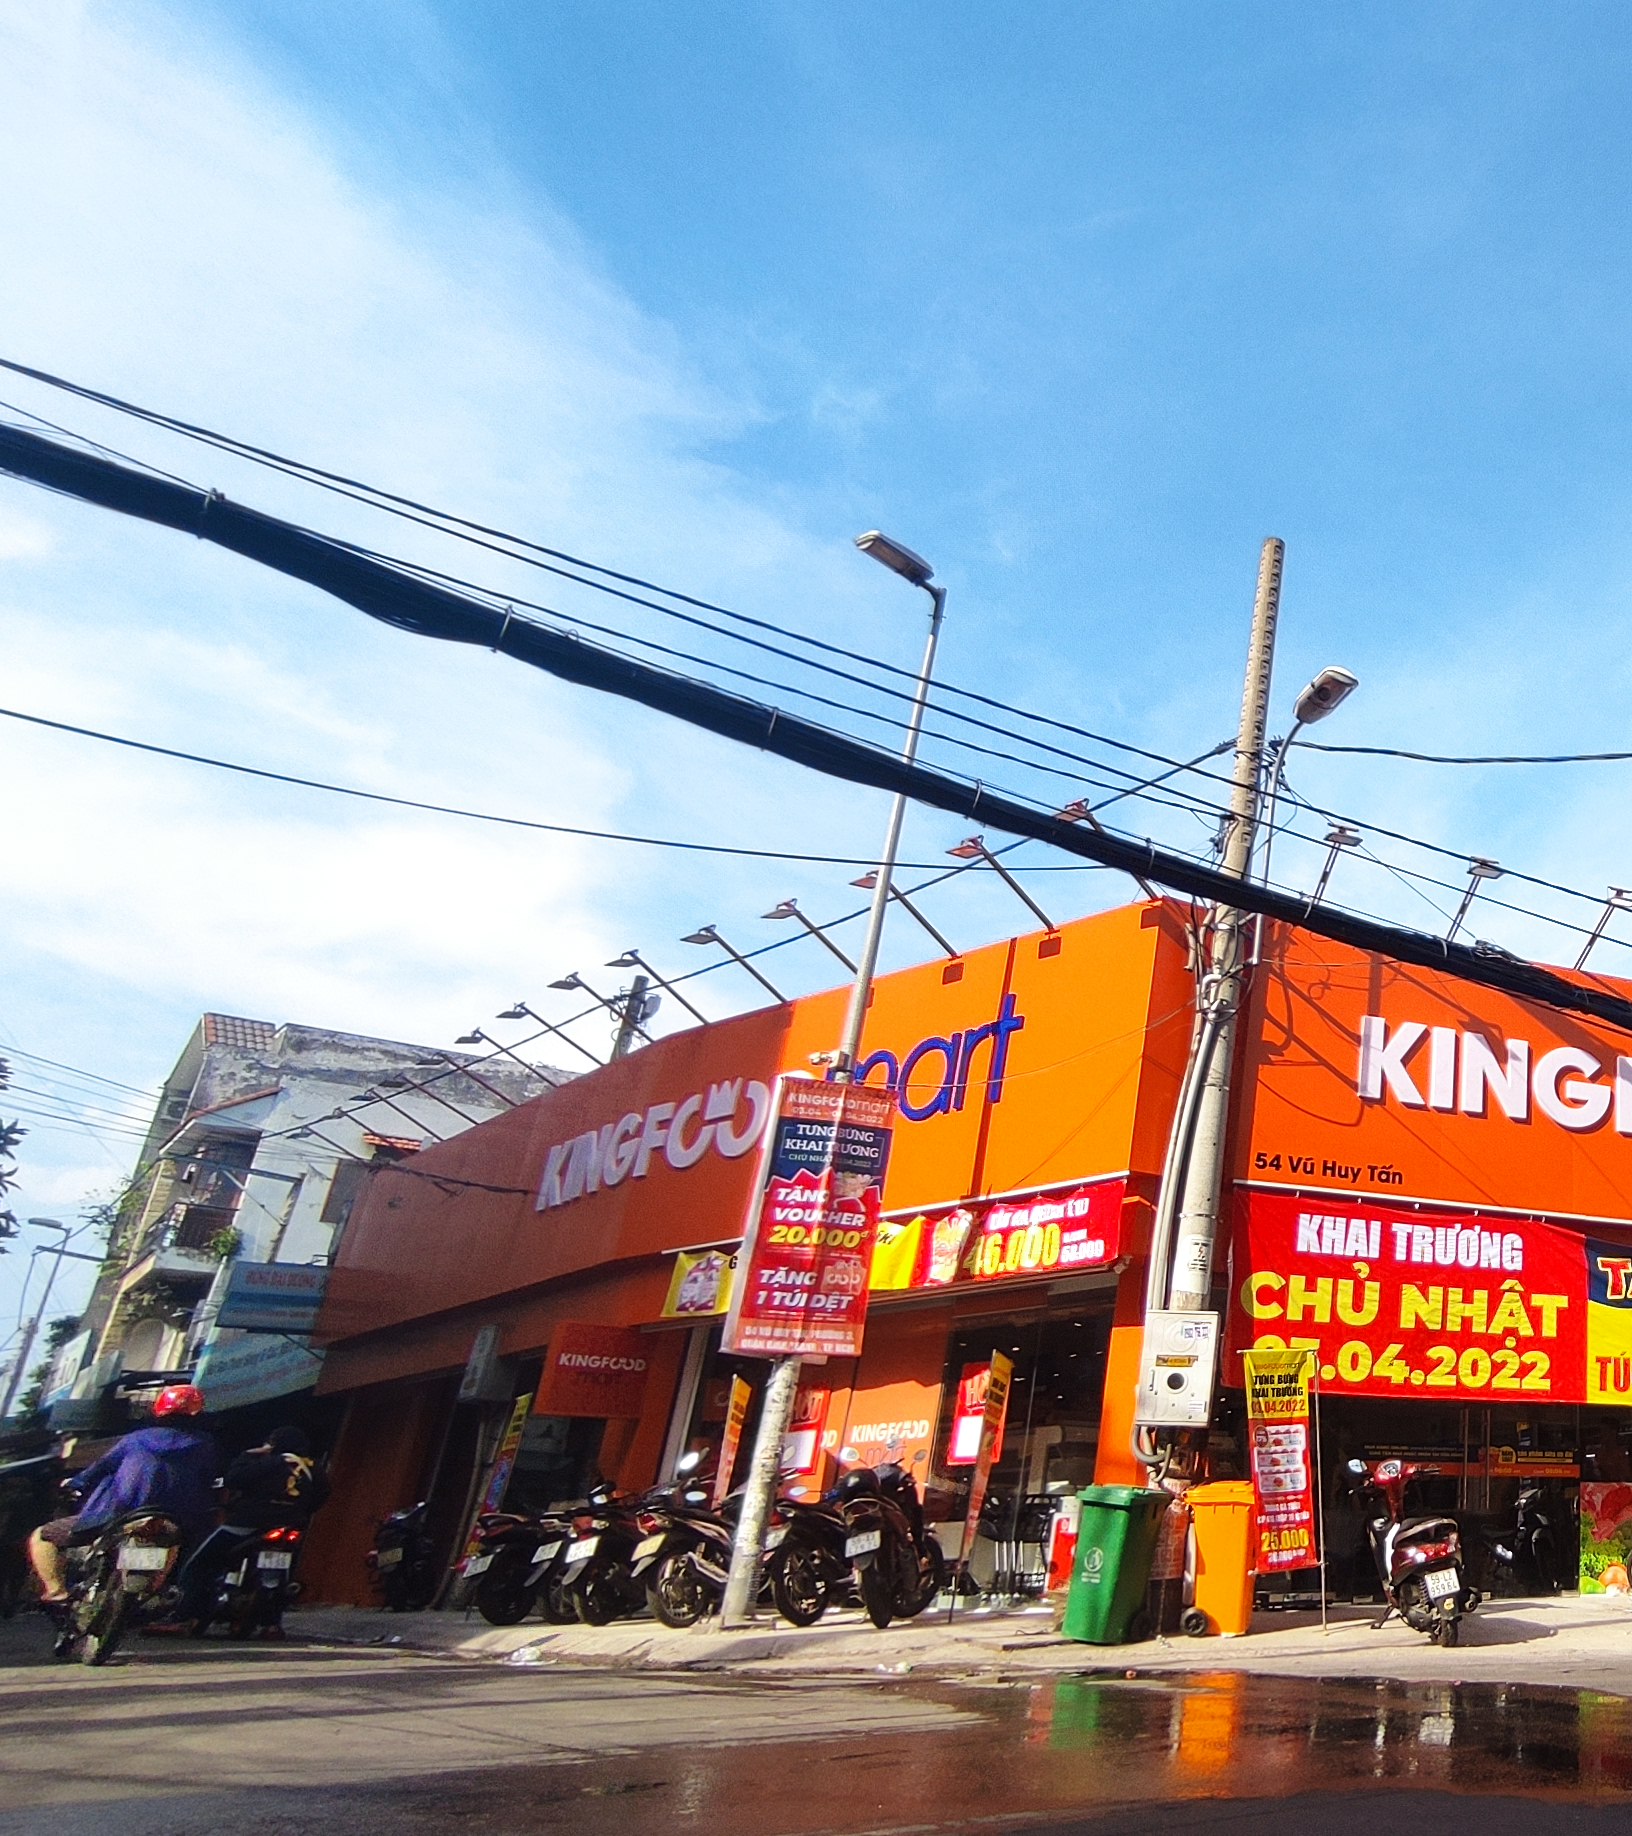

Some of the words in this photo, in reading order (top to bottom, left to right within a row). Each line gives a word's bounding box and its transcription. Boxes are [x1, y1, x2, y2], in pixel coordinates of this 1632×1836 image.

[534, 1077, 771, 1212] KINGFOO
[785, 1138, 823, 1151] KHAI
[1254, 1152, 1282, 1171] 54
[1322, 1161, 1361, 1184] Huy
[1367, 1162, 1404, 1186] Tấn
[774, 1207, 866, 1227] VOUCHER
[1296, 1213, 1382, 1259] KHAI
[1392, 1223, 1524, 1271] TRƯƠNG
[759, 1266, 818, 1288] TẶNG
[756, 1291, 768, 1305] 1
[773, 1289, 808, 1308] TÚI
[810, 1291, 853, 1312] DỆT
[1240, 1261, 1381, 1327] CHỦ
[1400, 1279, 1569, 1349] NHẬT
[558, 1353, 647, 1372] KINGFOOD
[1253, 1334, 1551, 1391] .04.2022
[1261, 1528, 1310, 1553] 25.000
